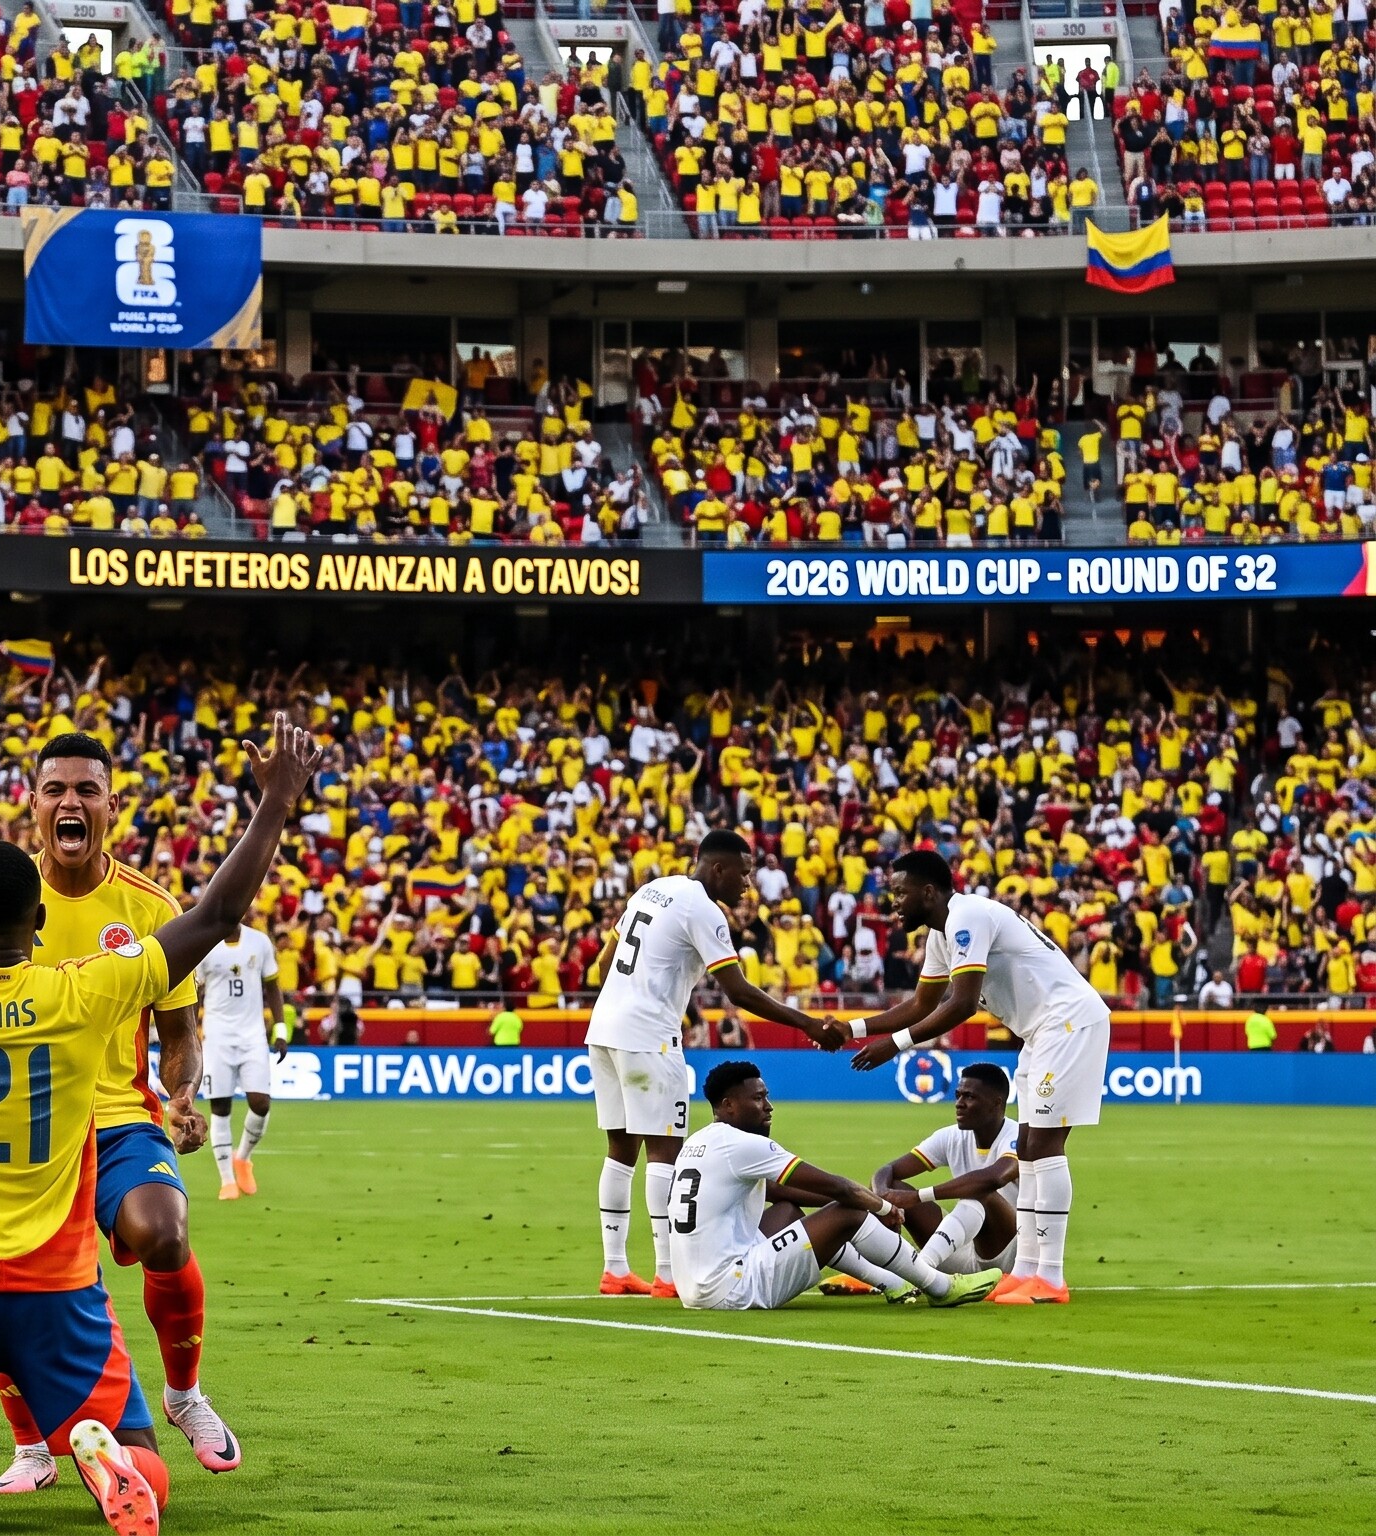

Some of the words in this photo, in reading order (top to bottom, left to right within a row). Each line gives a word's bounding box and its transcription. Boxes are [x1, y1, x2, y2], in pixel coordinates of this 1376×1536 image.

[70, 548, 129, 586] LOS
[135, 549, 310, 590] CAFETEROS
[316, 555, 456, 593] AVANZAN
[463, 557, 486, 593] A
[492, 557, 640, 596] OCTAVOS!
[766, 560, 849, 596] 2026
[855, 560, 970, 596] WORLD
[976, 559, 1040, 595] CUP
[1047, 572, 1062, 581] -
[1068, 557, 1180, 593] ROUND
[1186, 556, 1228, 592] OF
[1234, 555, 1277, 591] 32
[616, 910, 653, 976] 5
[228, 979, 244, 997] 19
[675, 1101, 686, 1129] 3
[667, 1168, 702, 1234] 3
